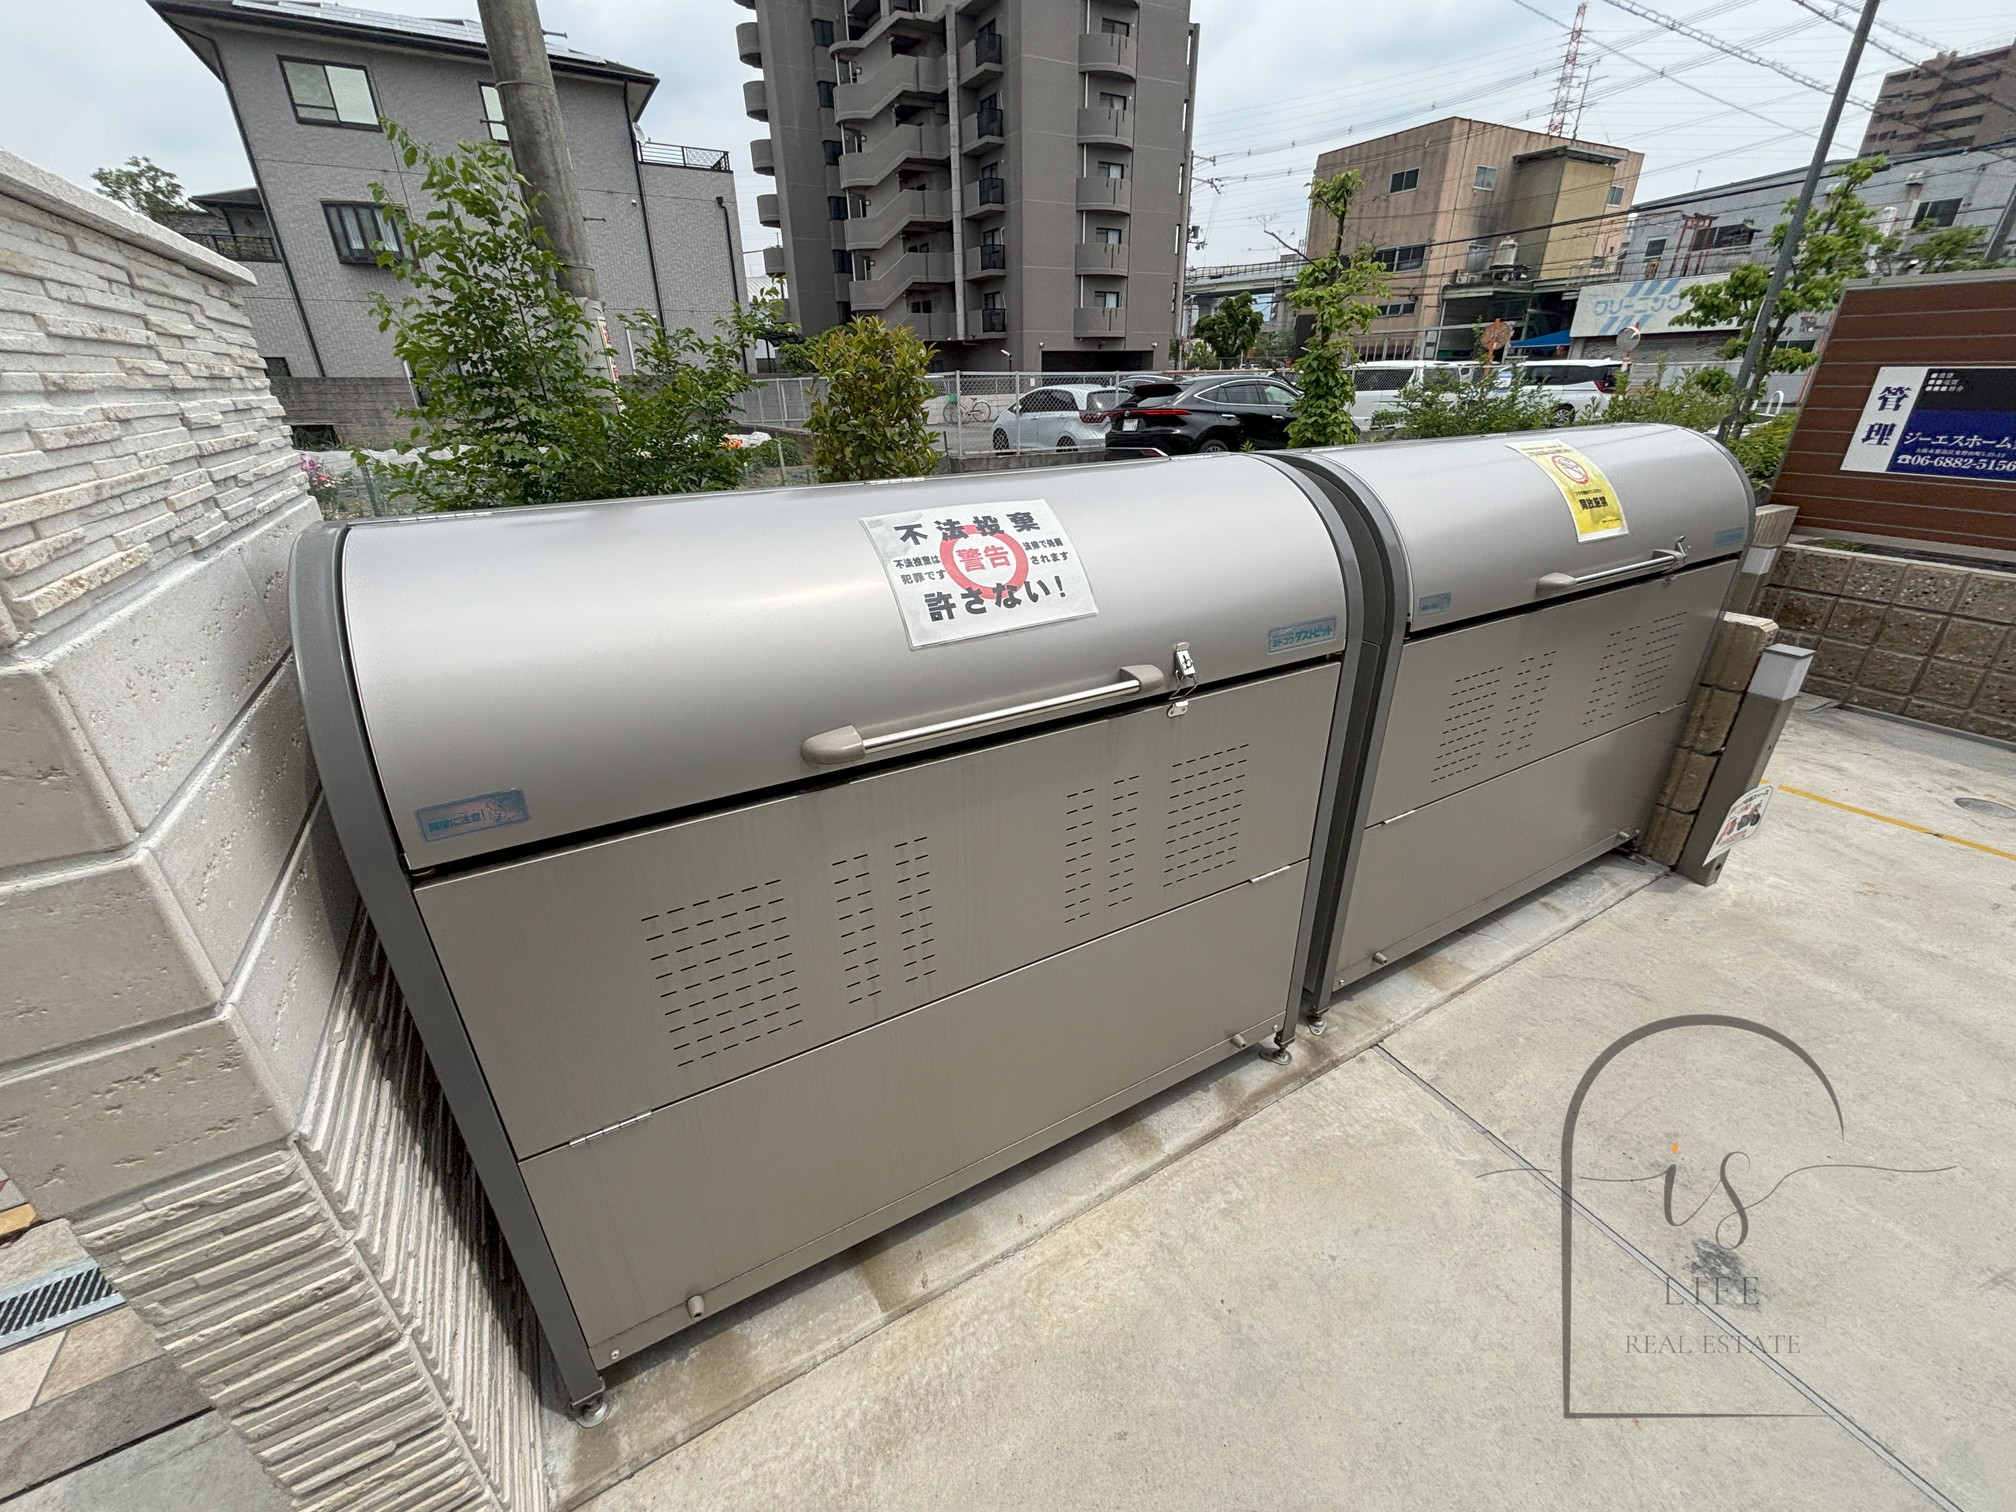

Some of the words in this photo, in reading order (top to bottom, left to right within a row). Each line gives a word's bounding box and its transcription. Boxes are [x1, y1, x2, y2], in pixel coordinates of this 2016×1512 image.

[1862, 386, 1912, 447] 管理
[1904, 432, 2016, 450] ジーエスホーム
[1911, 455, 2016, 472] 06-6882-5156
[894, 512, 1040, 545] 不法投棄
[893, 555, 941, 569] 不法投棄は
[955, 545, 1011, 573] 警告
[1029, 551, 1069, 565] されます
[900, 569, 946, 585] 犯罪です
